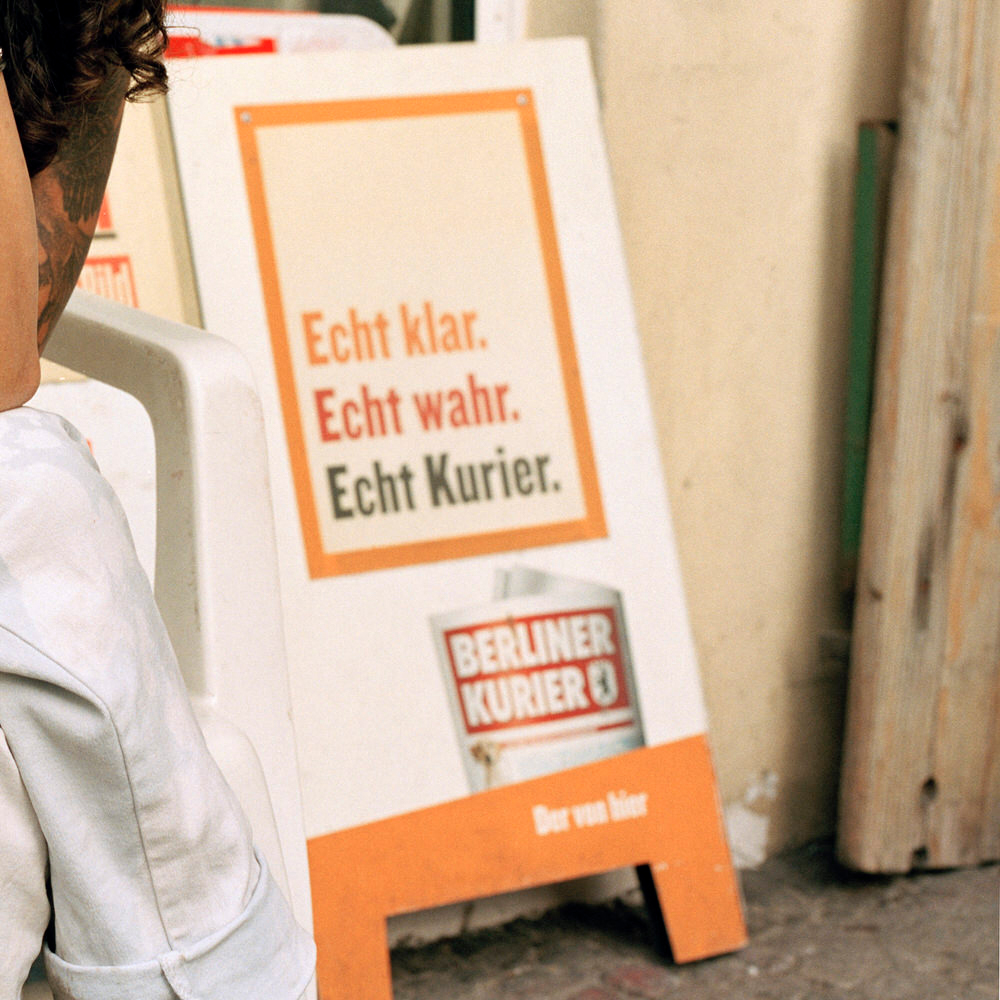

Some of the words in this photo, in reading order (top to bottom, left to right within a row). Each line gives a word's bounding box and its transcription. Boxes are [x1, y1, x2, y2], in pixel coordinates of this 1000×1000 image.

[301, 307, 391, 366] Echt
[399, 300, 488, 358] klar.
[313, 384, 402, 443] Echt
[411, 373, 520, 432] wahr.
[326, 460, 416, 520] Echt
[424, 446, 561, 508] Kurier.
[447, 612, 615, 678] BERLINER
[459, 665, 590, 727] KURIER
